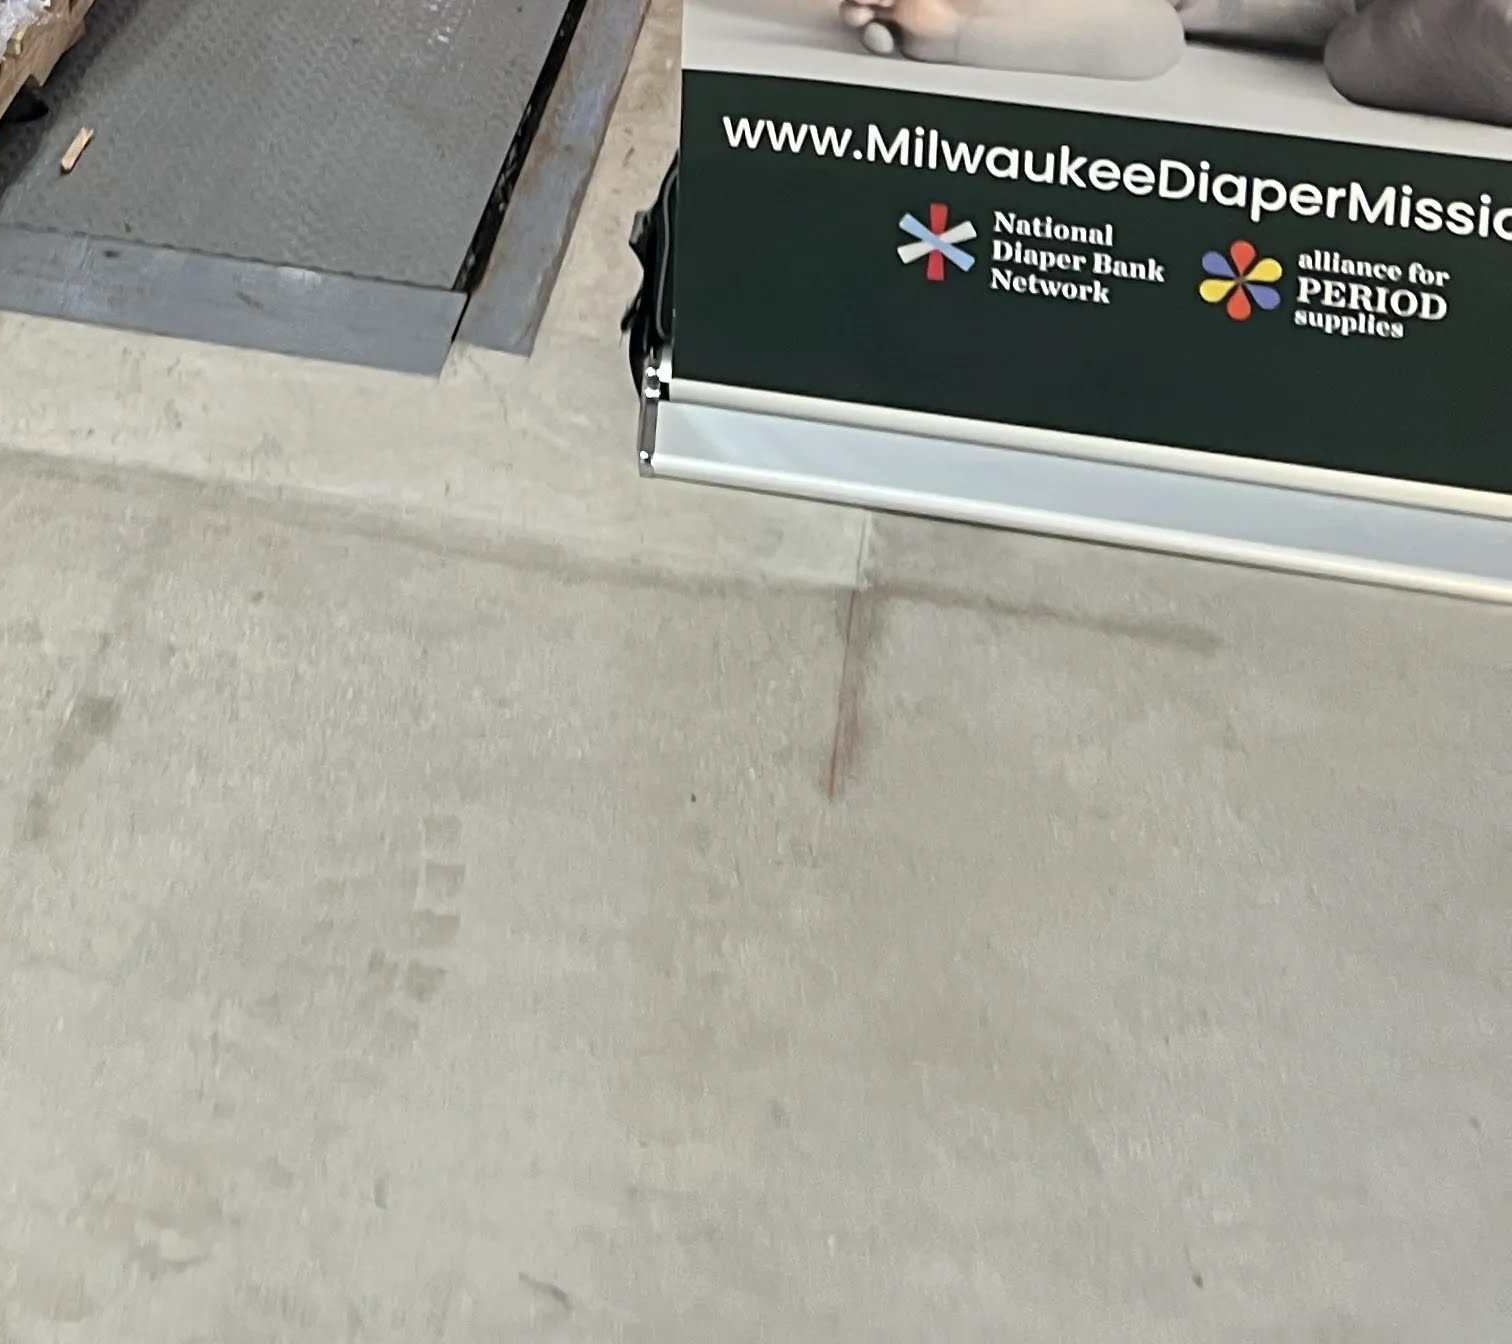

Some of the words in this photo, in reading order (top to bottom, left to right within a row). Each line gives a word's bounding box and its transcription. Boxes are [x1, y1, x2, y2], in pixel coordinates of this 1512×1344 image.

[993, 210, 1114, 247] National
[992, 238, 1088, 273] Diaper
[1092, 251, 1166, 283] Bank
[1298, 249, 1403, 282] alliance
[1408, 261, 1451, 288] for
[990, 266, 1111, 305] Network
[1296, 275, 1449, 321] PERIOD
[1294, 310, 1405, 339] supplies
